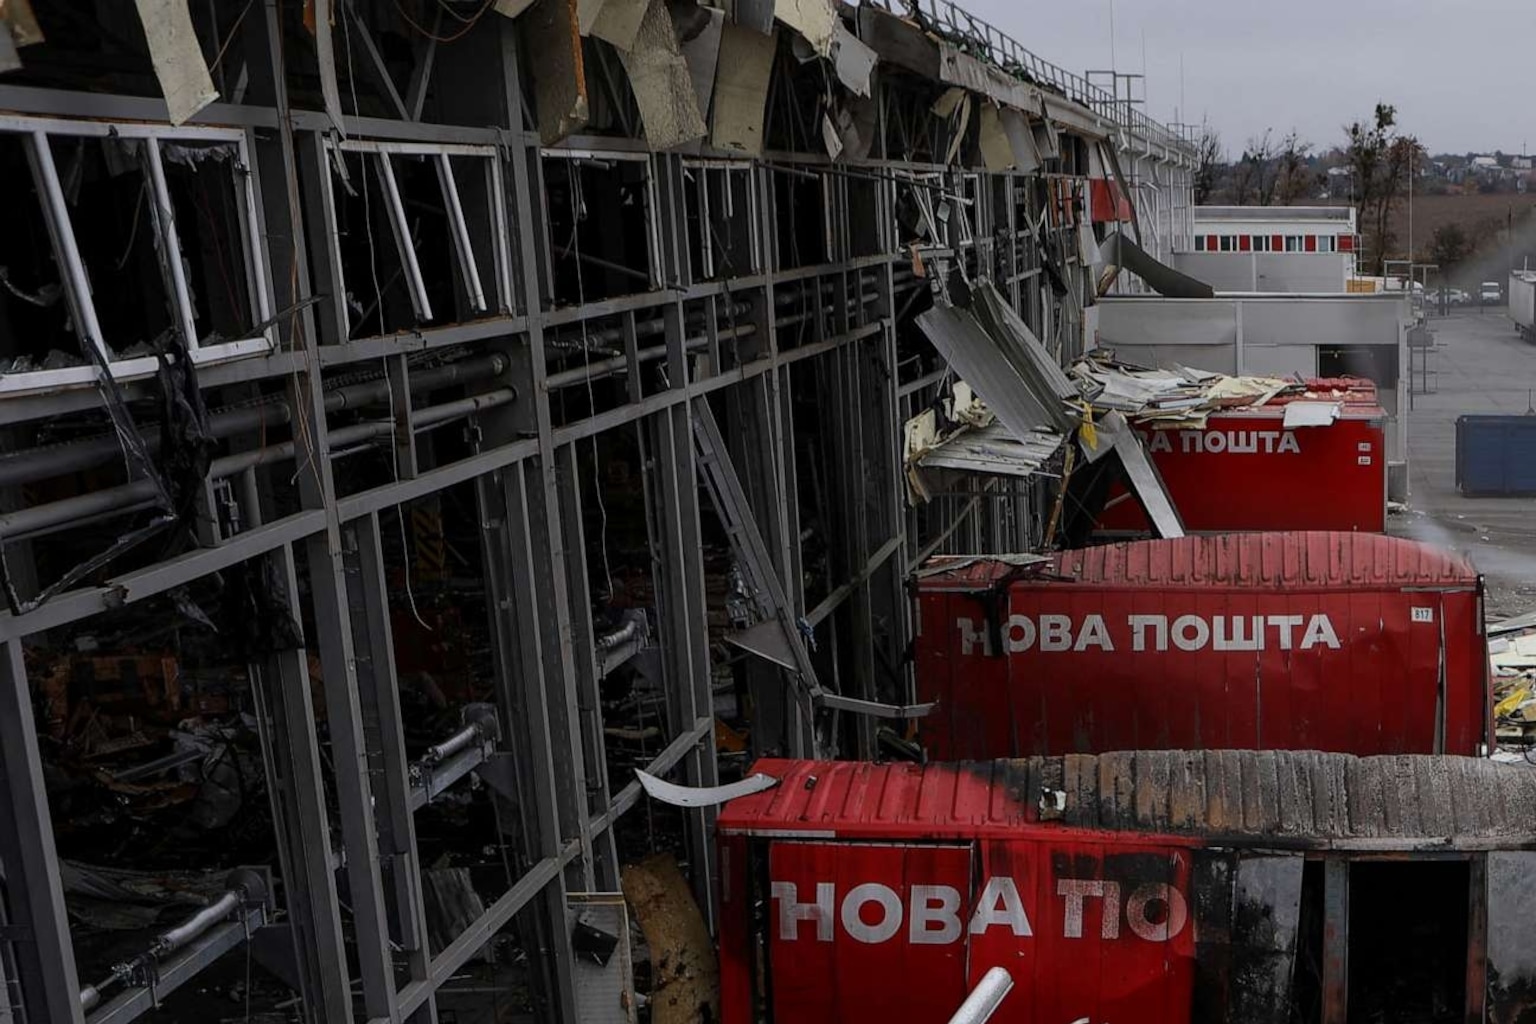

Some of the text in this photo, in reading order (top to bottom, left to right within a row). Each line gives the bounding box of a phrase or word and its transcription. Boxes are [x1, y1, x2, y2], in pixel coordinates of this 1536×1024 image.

[1179, 430, 1301, 453] ПОШТА
[957, 614, 1342, 656] НОВА ПОШТА
[771, 876, 1033, 944] НОВА
